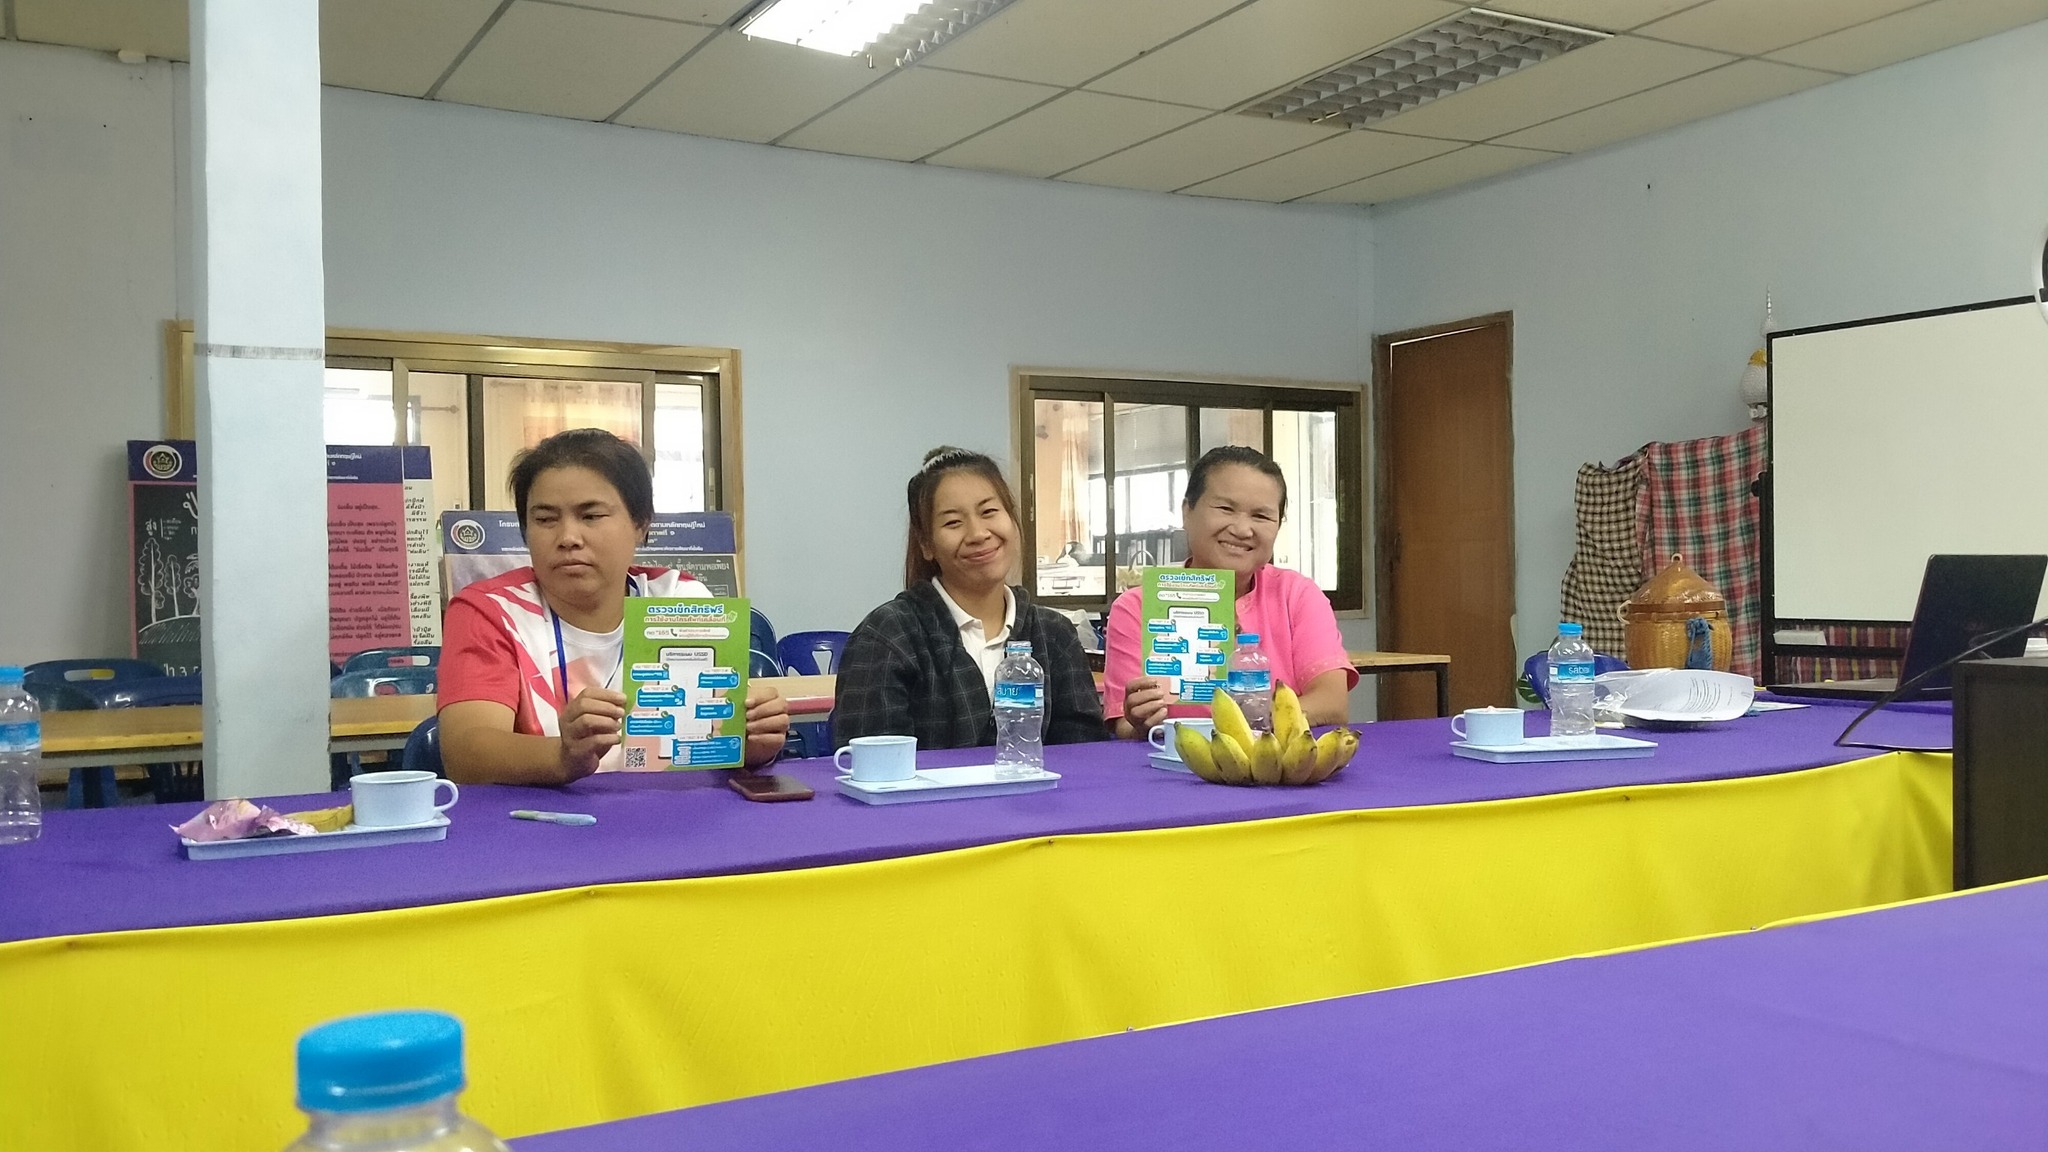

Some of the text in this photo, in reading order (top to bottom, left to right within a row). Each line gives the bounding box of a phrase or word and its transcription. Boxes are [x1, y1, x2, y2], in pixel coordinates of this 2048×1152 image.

[647, 602, 724, 614] ตรวจเช็กสิทธิฟรี
